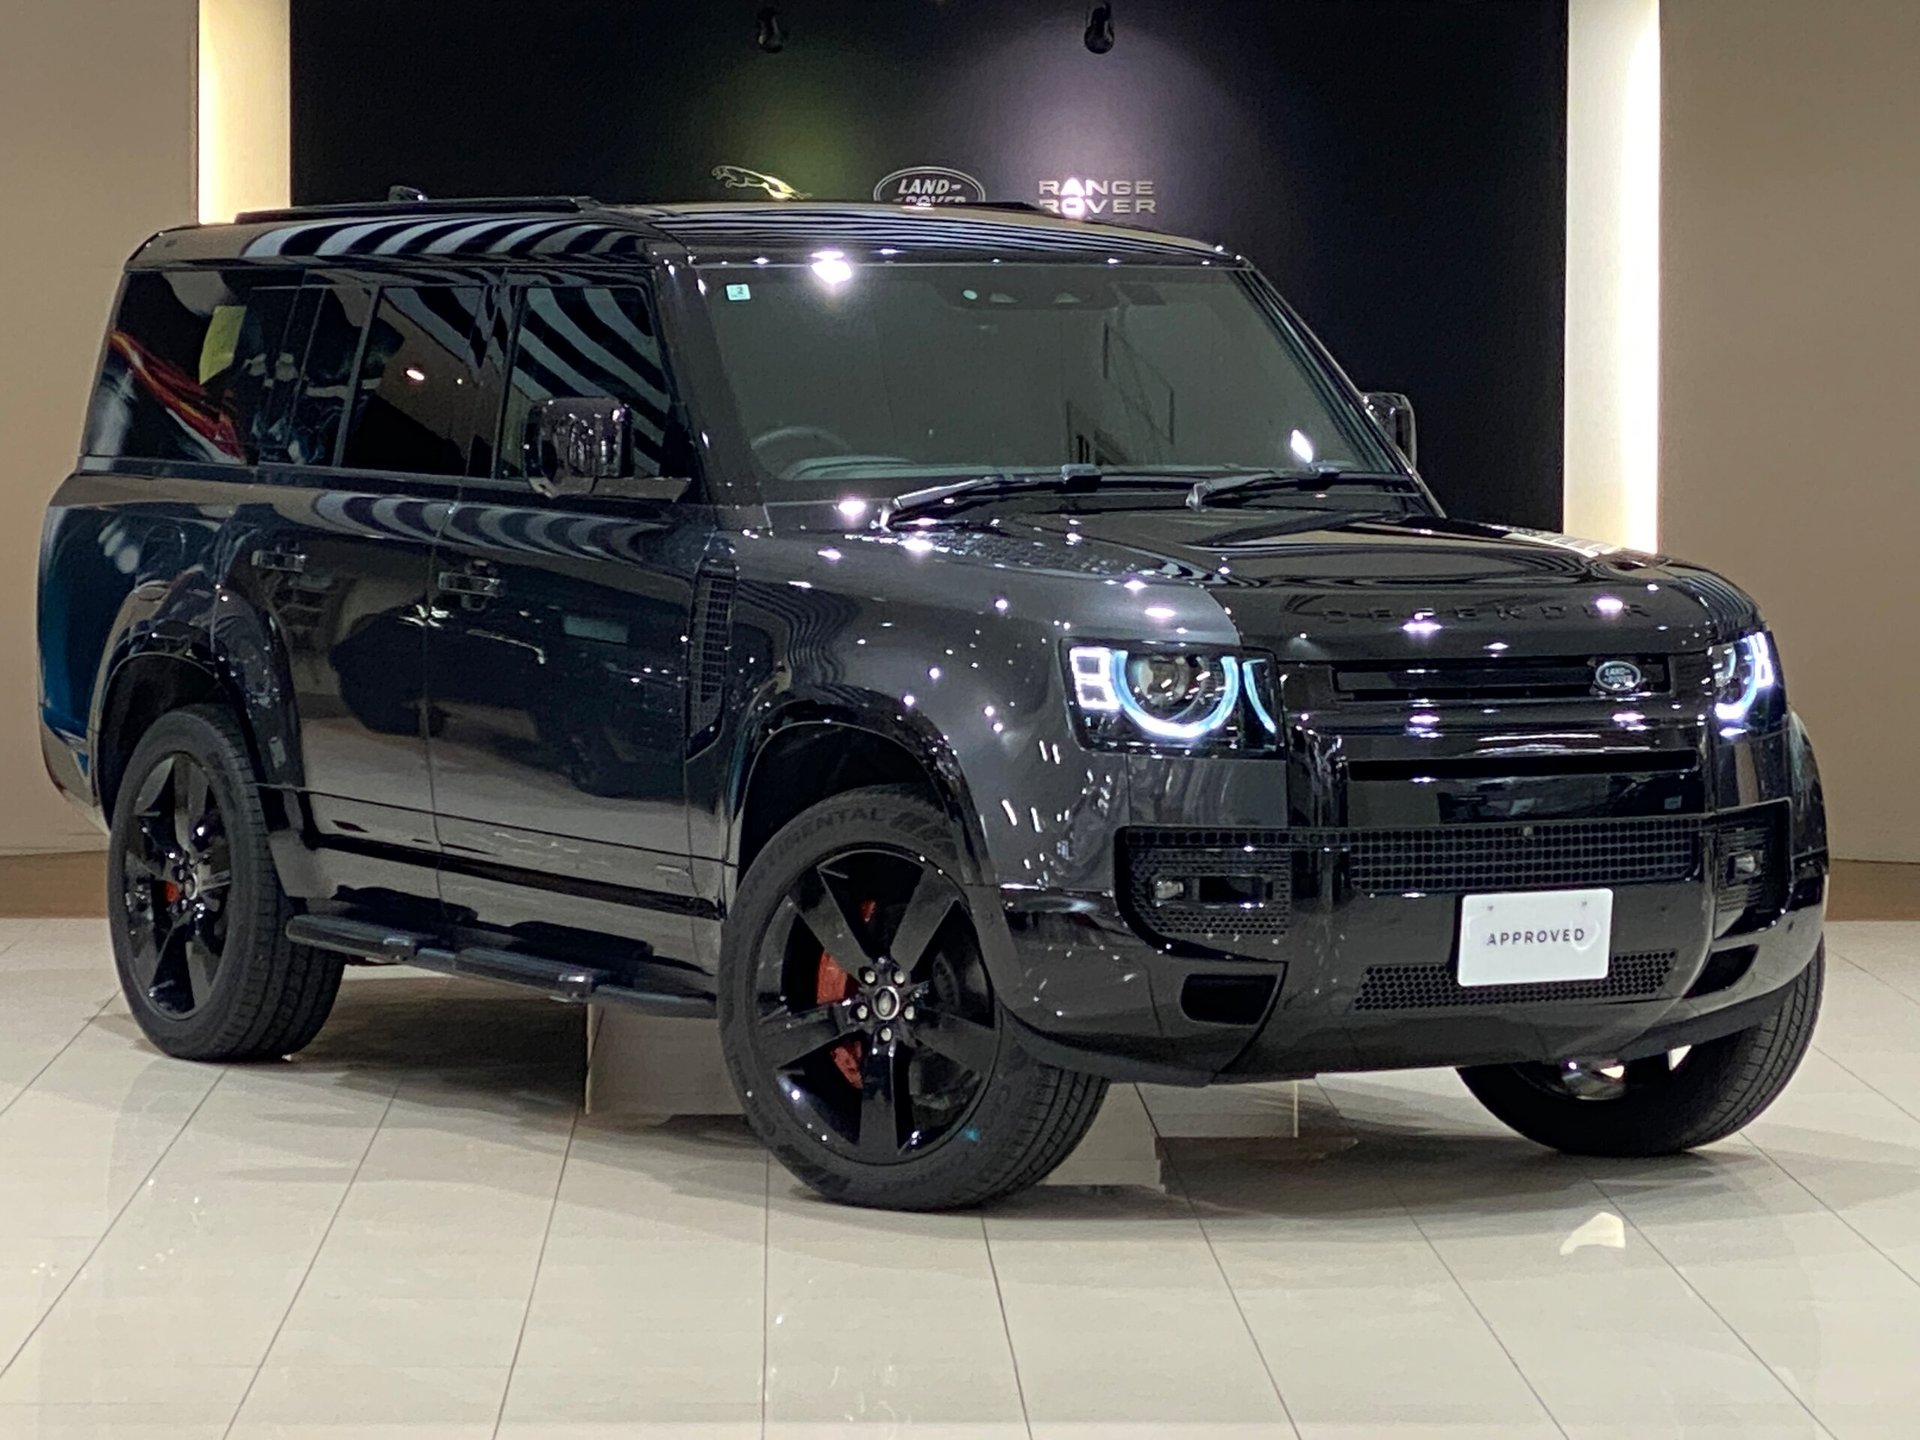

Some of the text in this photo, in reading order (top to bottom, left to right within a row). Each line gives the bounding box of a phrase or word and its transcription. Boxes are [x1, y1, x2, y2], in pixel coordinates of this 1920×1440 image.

[1038, 178, 1154, 196] RANGE
[1038, 197, 1157, 217] ROVER
[1486, 928, 1585, 946] APPROVED
